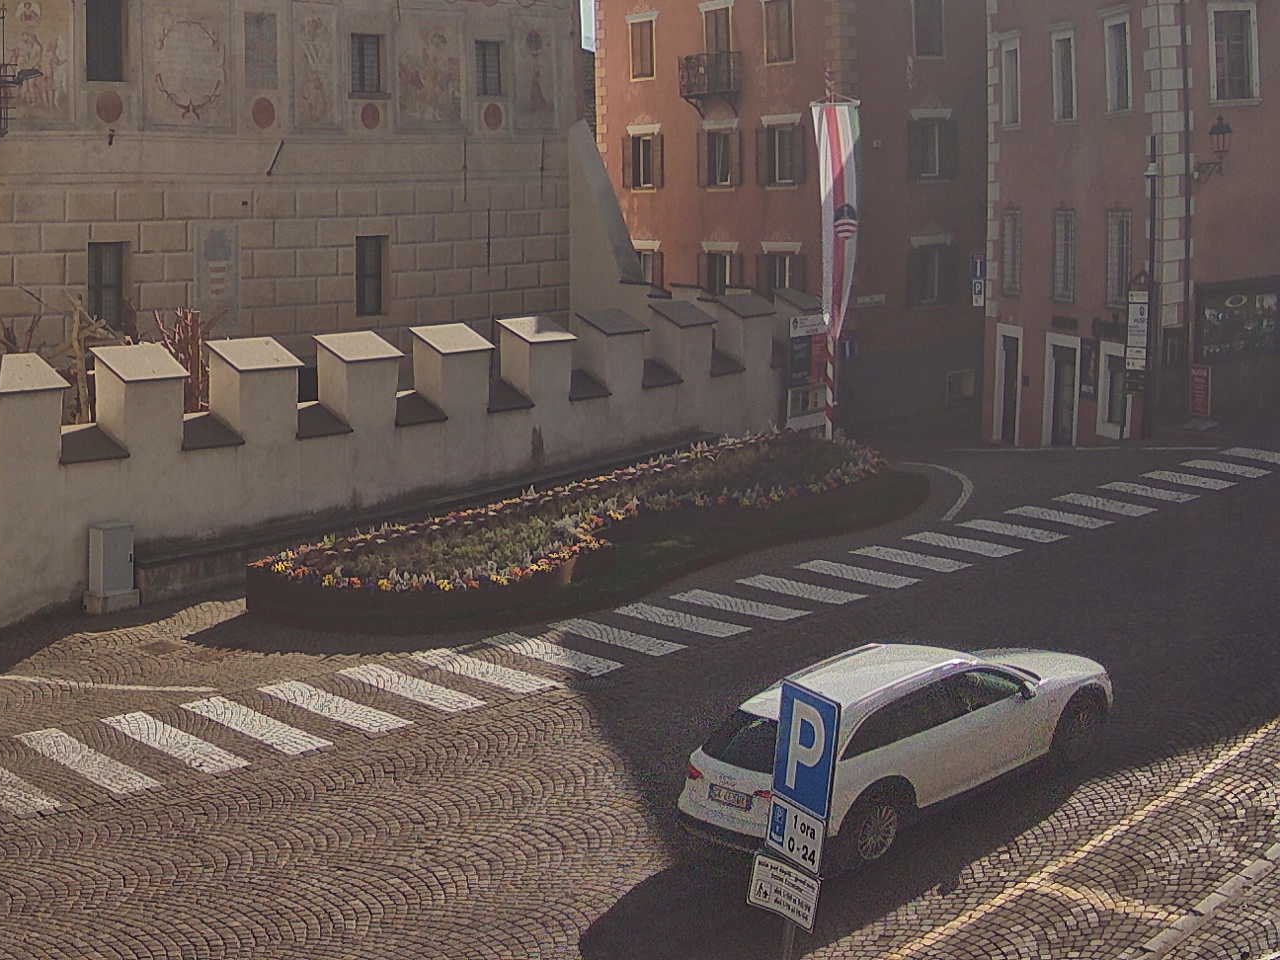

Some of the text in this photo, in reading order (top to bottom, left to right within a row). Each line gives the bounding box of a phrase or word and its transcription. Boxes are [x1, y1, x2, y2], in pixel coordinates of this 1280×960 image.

[785, 697, 826, 790] P
[793, 814, 816, 840] 1 ora
